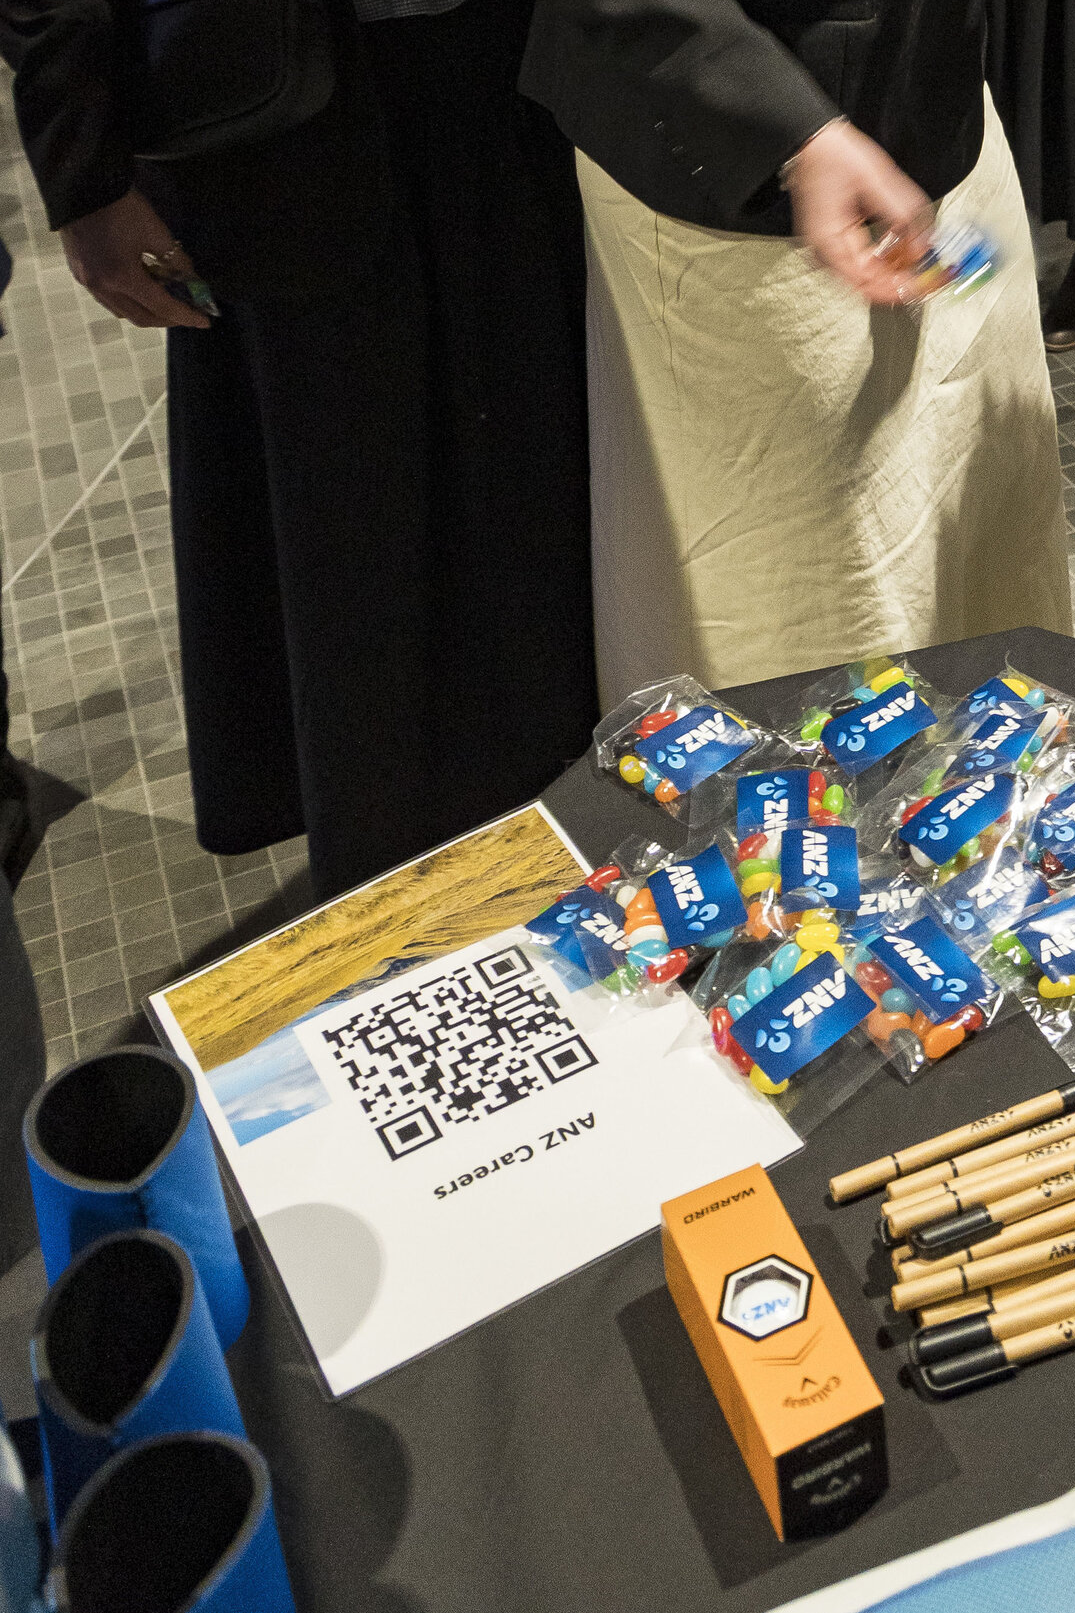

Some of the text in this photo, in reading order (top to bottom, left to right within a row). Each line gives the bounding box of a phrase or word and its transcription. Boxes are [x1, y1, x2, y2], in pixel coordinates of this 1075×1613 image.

[675, 712, 725, 753] ANZ
[860, 690, 915, 732] ANZ
[977, 718, 1021, 750] ANZ
[940, 773, 995, 820] ANZ
[803, 830, 828, 876] ANZ
[665, 865, 704, 910] ANZ
[857, 887, 925, 916] ANZ
[966, 862, 1025, 910] ANZ
[884, 935, 944, 981] ANZ
[782, 967, 846, 1029] ANZ
[433, 1112, 595, 1199] ANZ Careers
[683, 1187, 756, 1225] WARBIRD
[751, 1296, 790, 1321] ANZ
